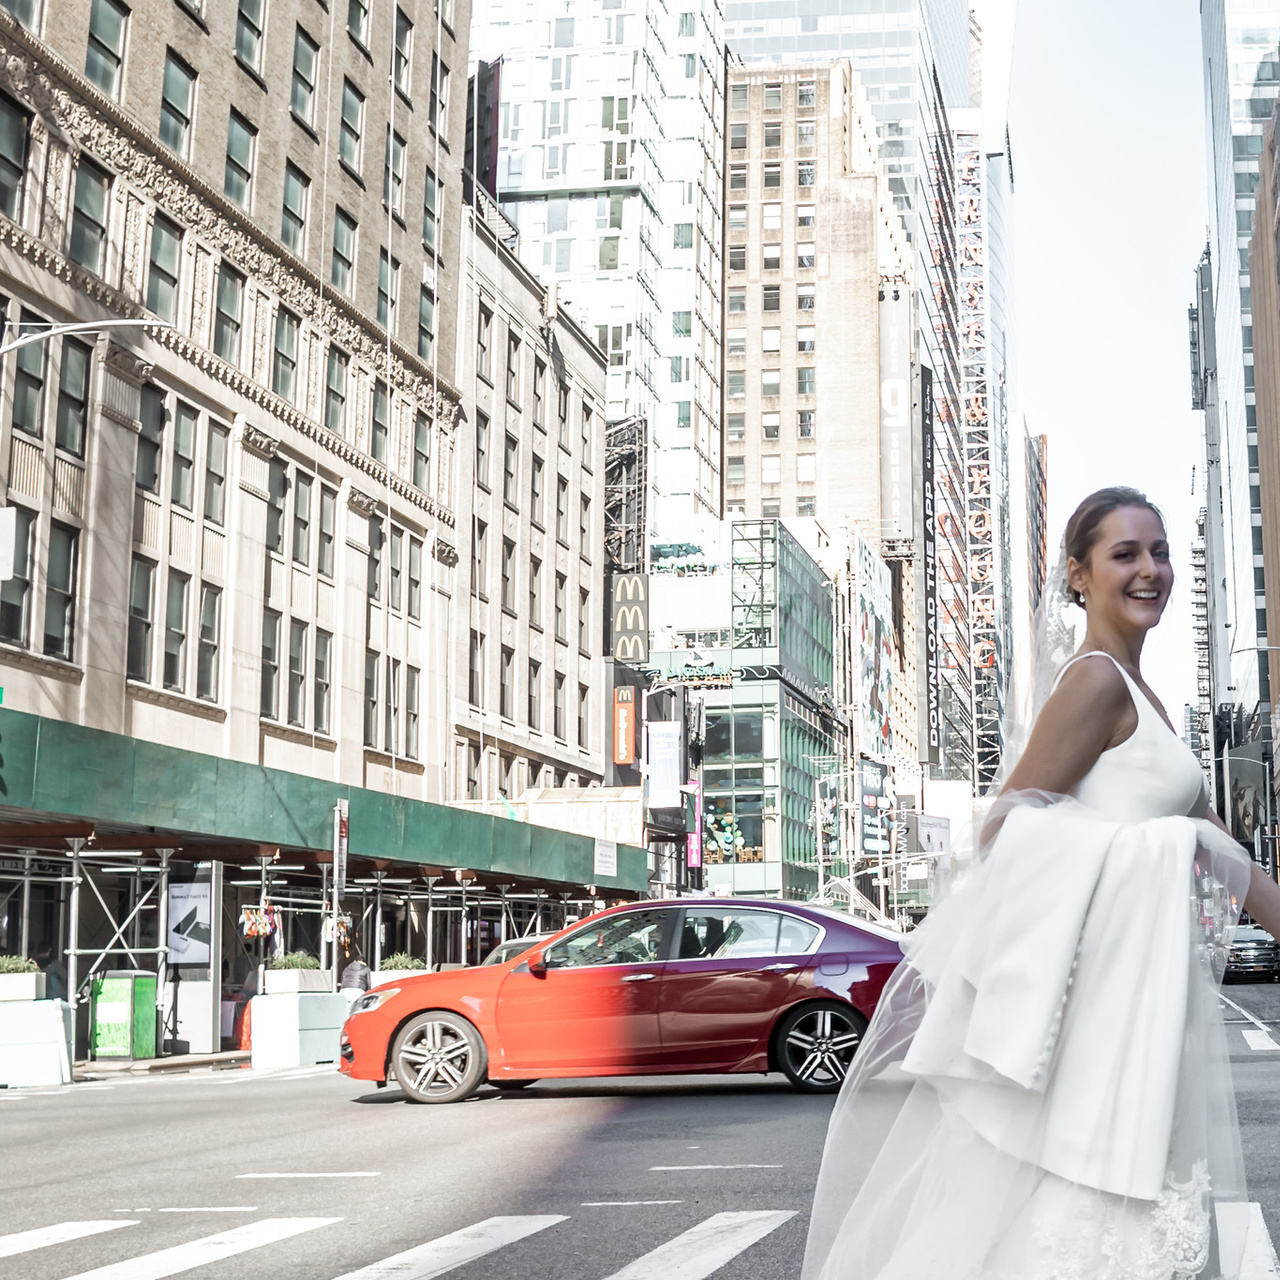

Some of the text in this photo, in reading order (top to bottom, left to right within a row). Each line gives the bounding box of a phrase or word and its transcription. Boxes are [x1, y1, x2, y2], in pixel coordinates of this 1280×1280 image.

[961, 152, 996, 668] ERNST & YOUNG
[618, 708, 628, 760] McDonald's
[925, 488, 938, 747] DOWNLOAD THE APP
